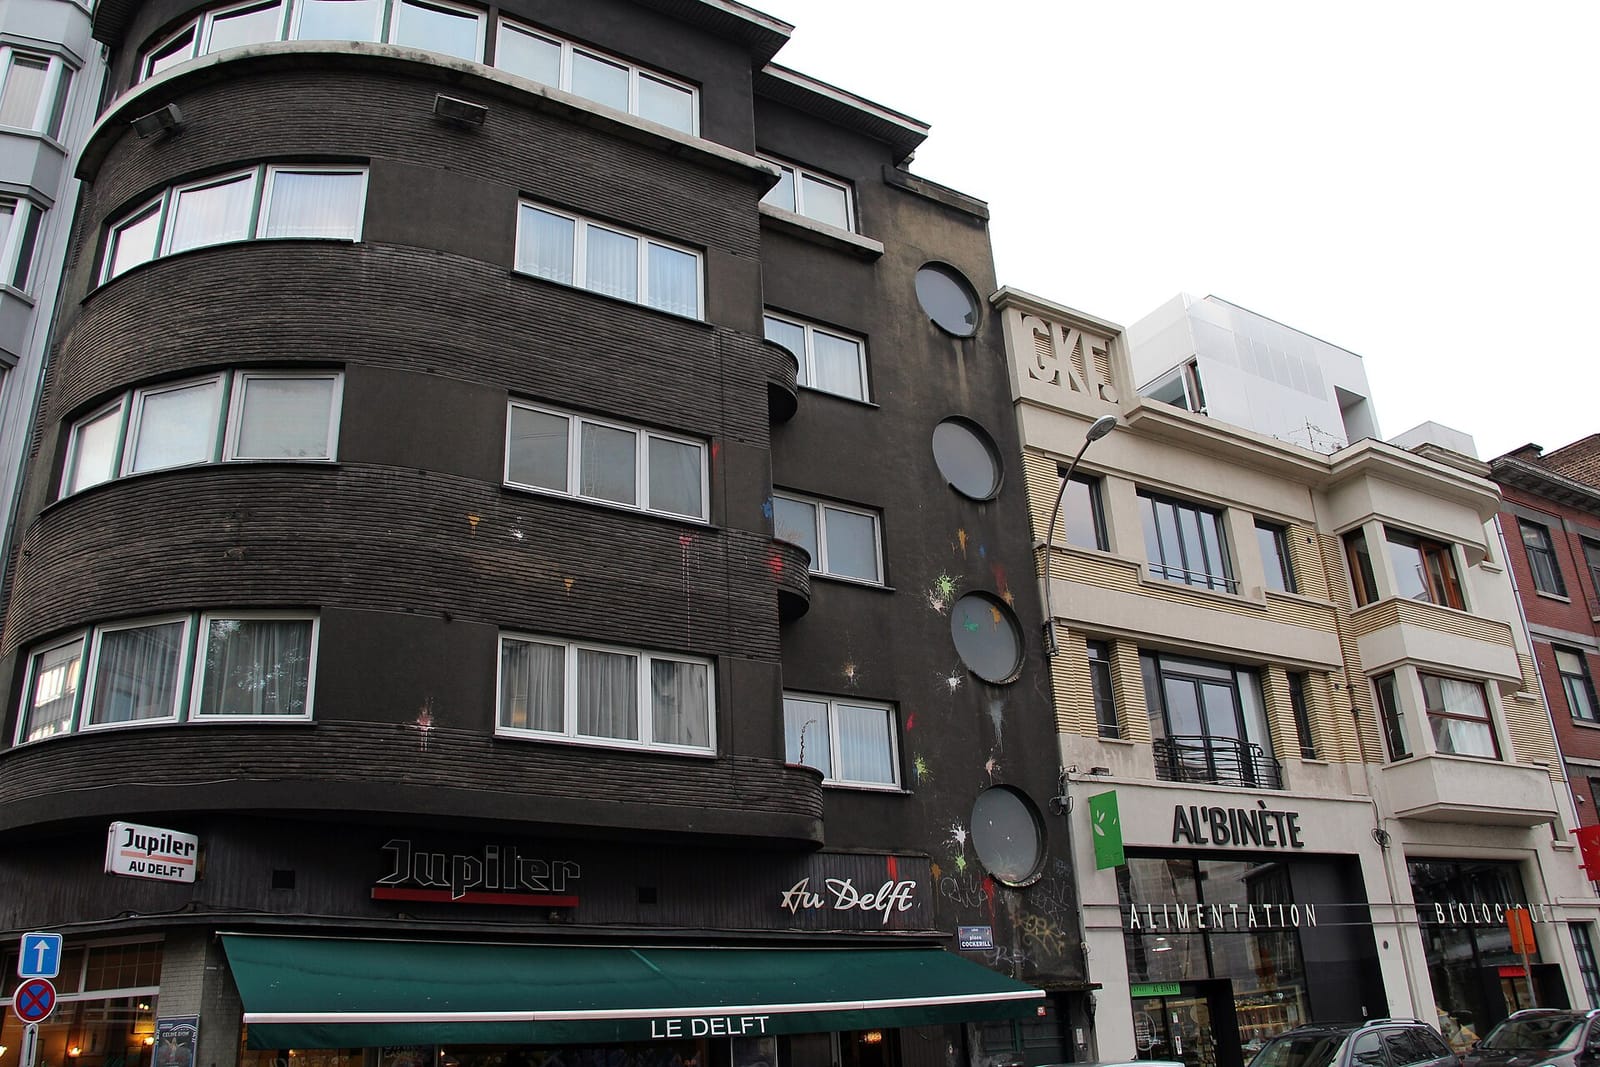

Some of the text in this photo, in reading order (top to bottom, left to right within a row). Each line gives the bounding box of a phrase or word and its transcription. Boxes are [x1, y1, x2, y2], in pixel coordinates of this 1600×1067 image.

[1172, 800, 1304, 847] AL'BINÈTE
[122, 827, 195, 856] Jupiler
[129, 861, 184, 878] AU DELFT
[376, 839, 581, 901] Jupiler
[781, 877, 825, 915] Au
[825, 879, 916, 925] Delft
[1434, 903, 1549, 924] BIOLOGUE
[1130, 903, 1317, 929] ALIMENTATION
[961, 940, 991, 948] COCKERILL
[651, 1016, 769, 1038] LE DELFT
